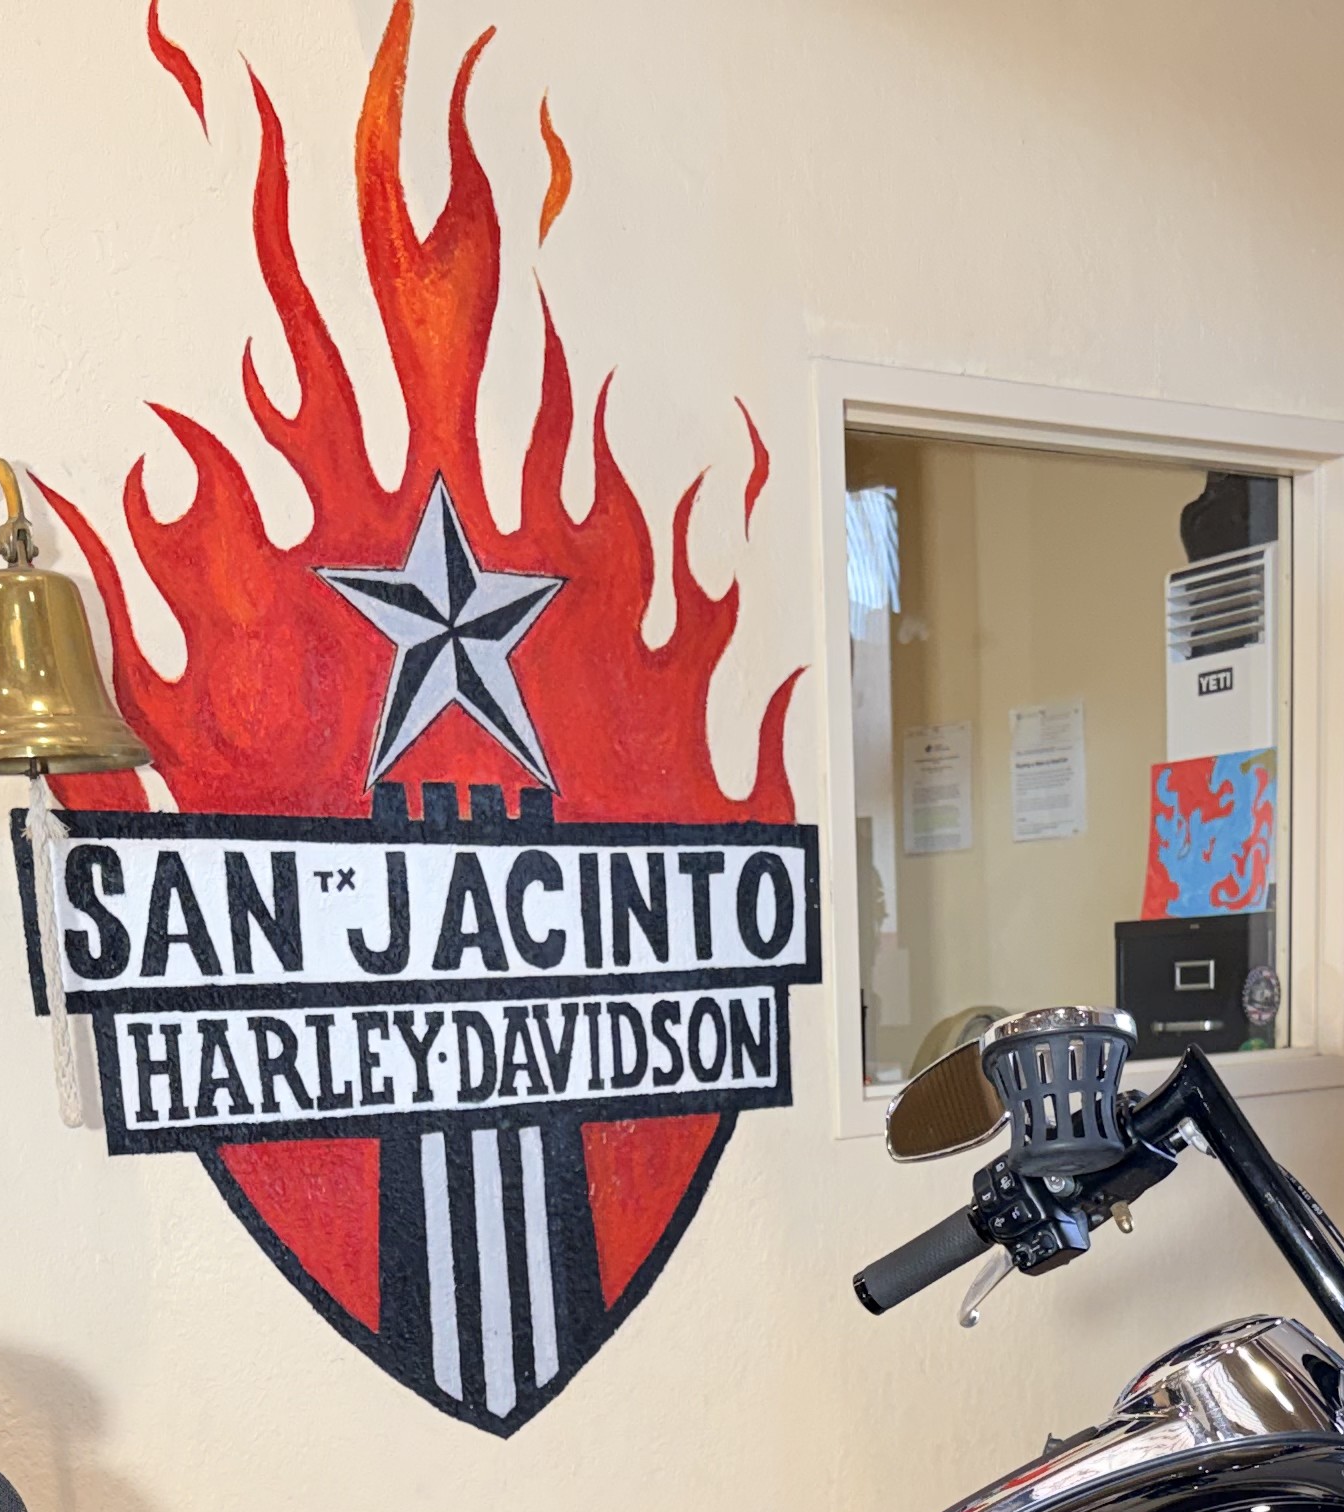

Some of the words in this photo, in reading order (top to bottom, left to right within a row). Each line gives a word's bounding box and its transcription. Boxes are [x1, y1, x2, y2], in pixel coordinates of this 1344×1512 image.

[1199, 671, 1232, 693] YETI
[313, 866, 357, 893] TX
[64, 843, 304, 980] SAN
[346, 848, 796, 976] JACINTO
